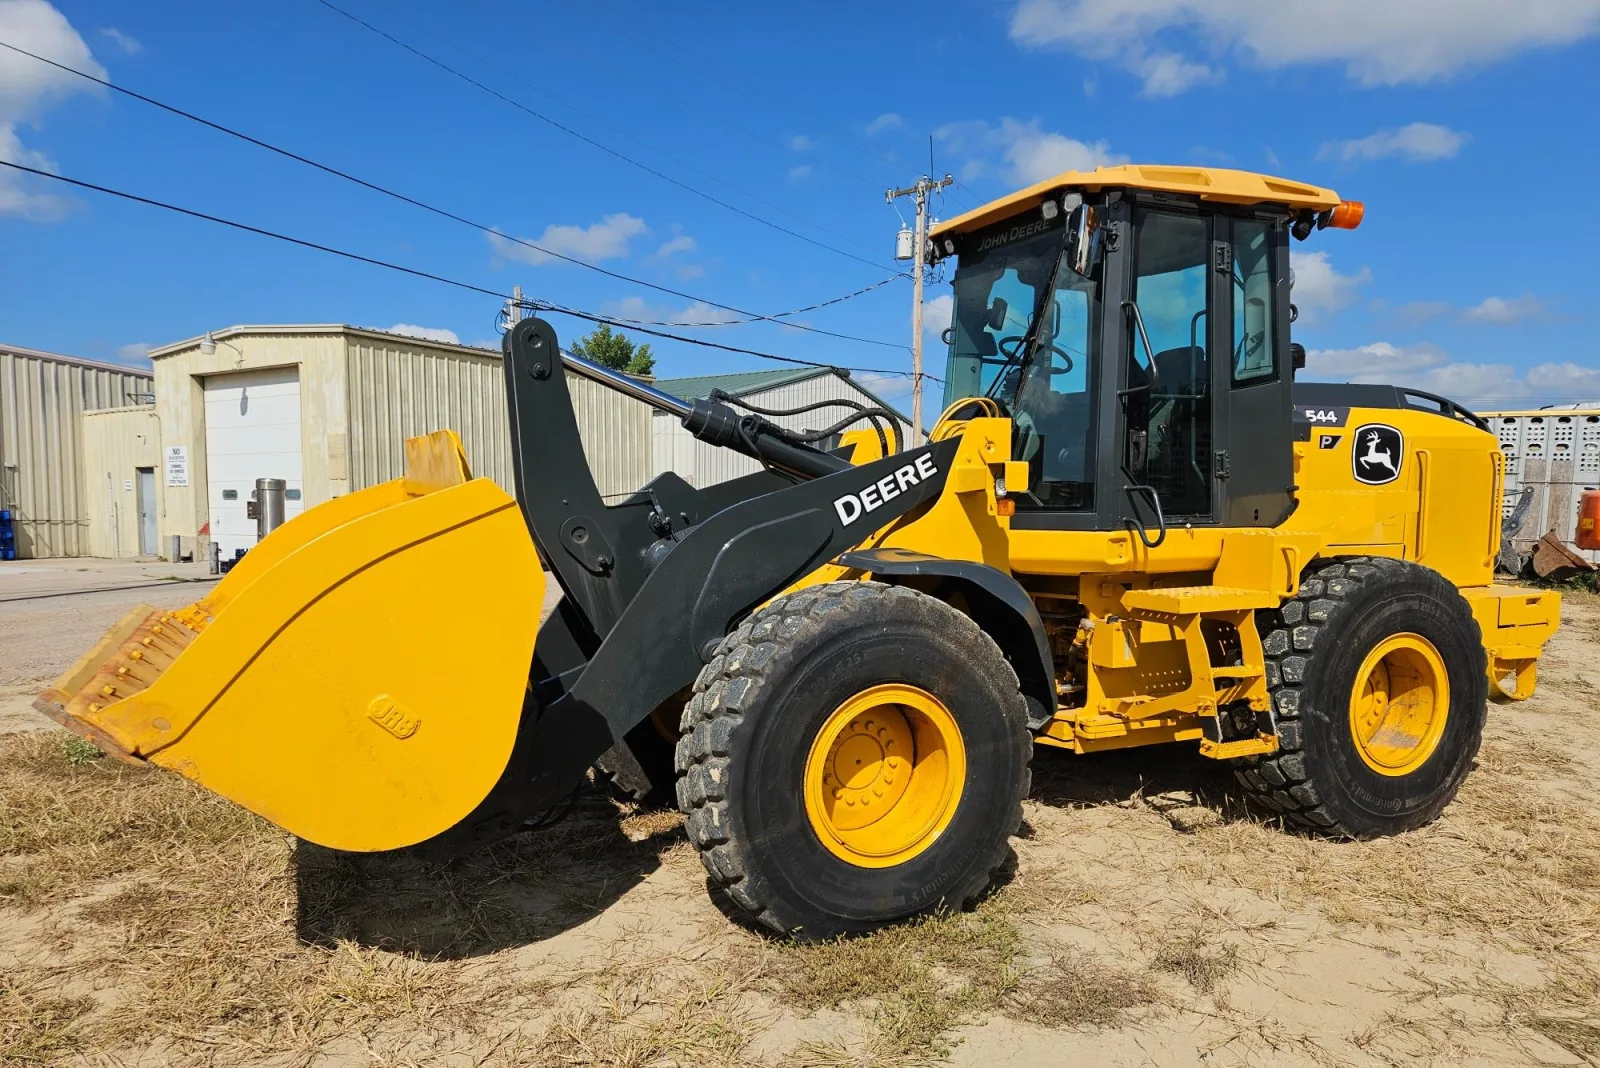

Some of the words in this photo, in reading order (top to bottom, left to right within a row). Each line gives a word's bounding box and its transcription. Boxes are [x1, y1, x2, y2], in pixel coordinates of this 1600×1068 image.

[977, 232, 1008, 252] JOHN
[1009, 221, 1050, 241] DEERE
[1305, 409, 1338, 423] 544
[1320, 435, 1333, 449] P
[833, 452, 938, 527] DEERE
[1354, 786, 1402, 811] Continental
